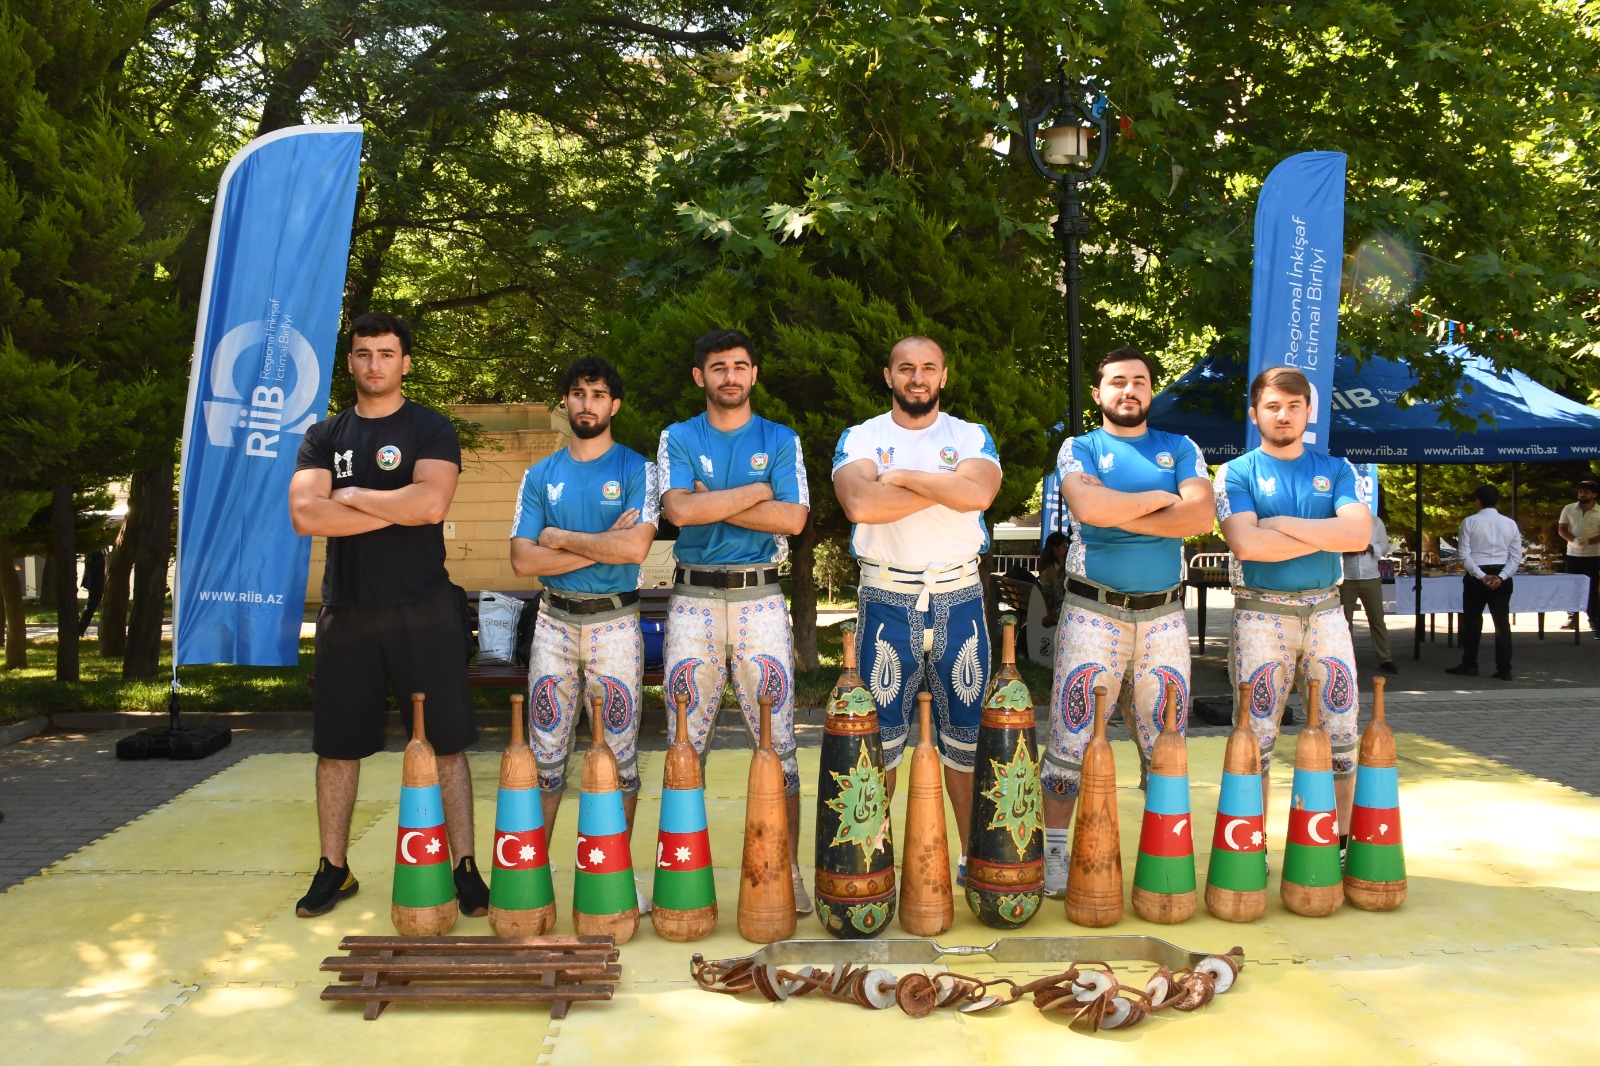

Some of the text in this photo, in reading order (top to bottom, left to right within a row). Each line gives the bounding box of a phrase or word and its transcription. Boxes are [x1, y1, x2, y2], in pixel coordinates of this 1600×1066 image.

[1306, 247, 1327, 301] Birliyi
[1284, 214, 1309, 367] Regional İnkişaf
[278, 314, 294, 343] Birliyi
[260, 333, 275, 380] Regional
[239, 385, 285, 458] RiiB
[1345, 445, 1408, 456] www.riib.az
[1423, 445, 1485, 456] www.riib.az
[1497, 444, 1558, 455] www.riib.az
[485, 617, 508, 628] Store
